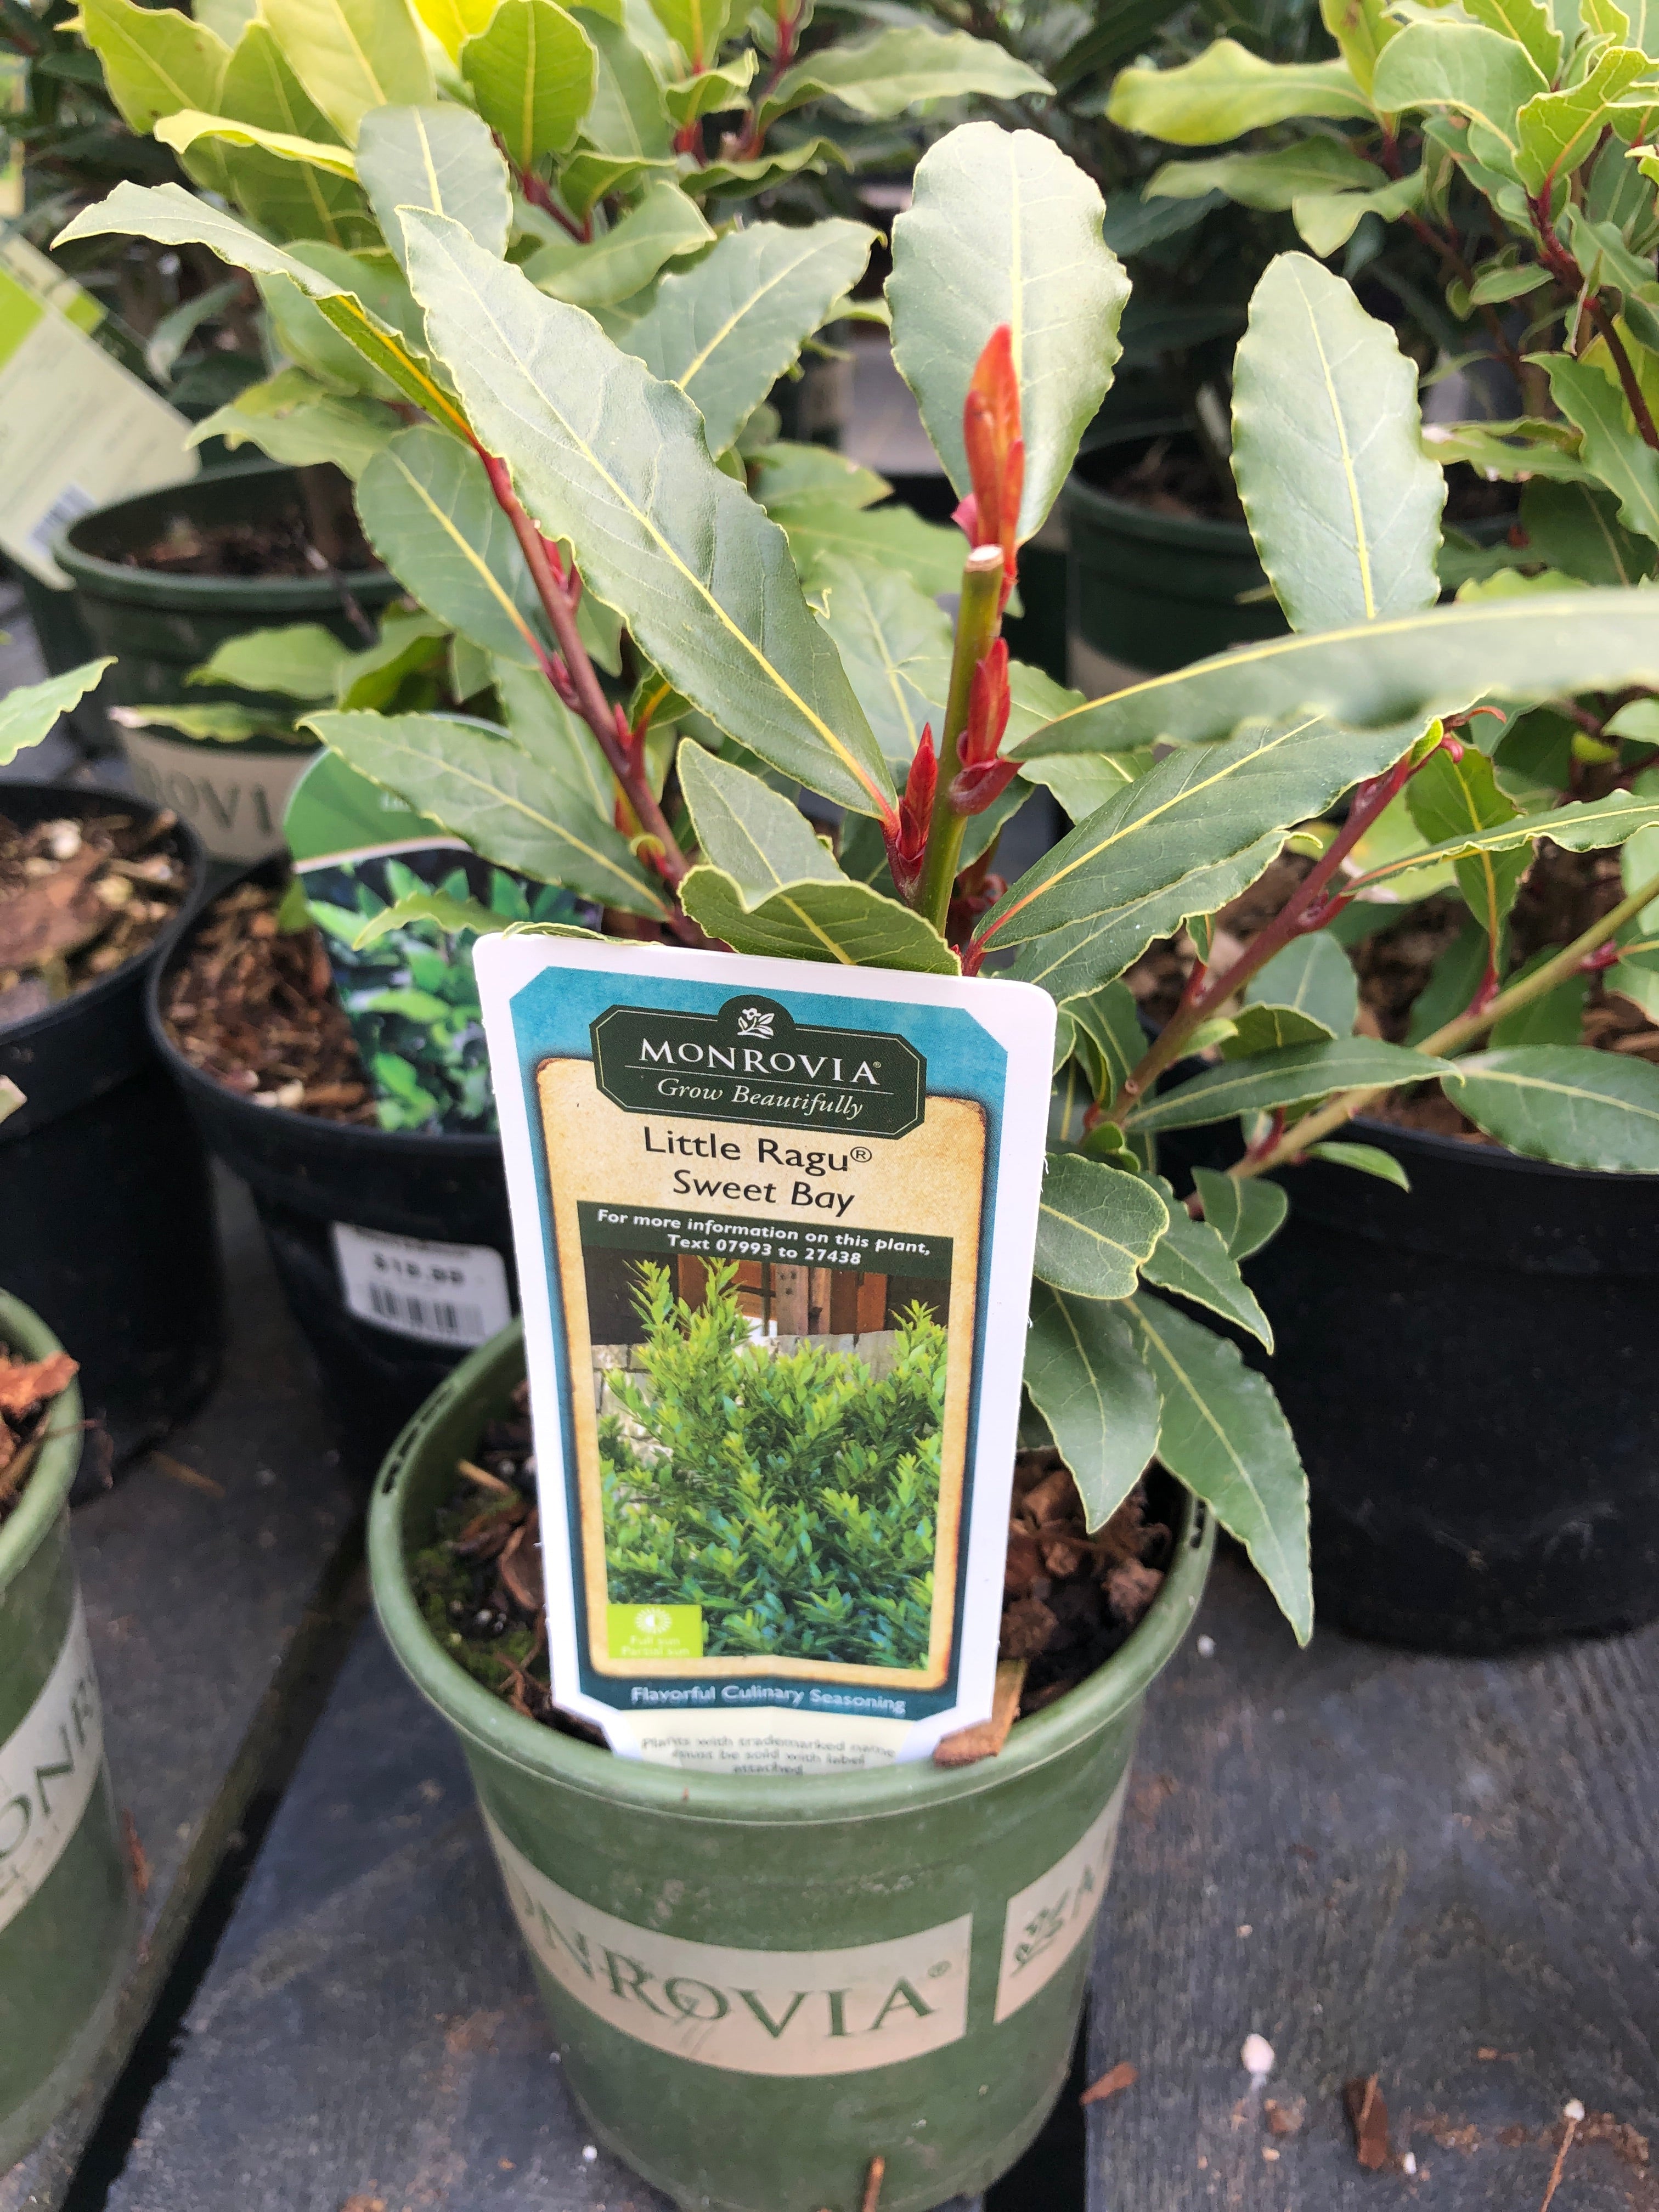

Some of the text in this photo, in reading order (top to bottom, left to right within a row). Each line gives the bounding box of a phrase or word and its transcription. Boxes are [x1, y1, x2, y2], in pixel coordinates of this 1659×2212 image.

[657, 1077, 864, 1120] Grow Beautifully
[644, 1126, 872, 1177] Little Ragu®
[673, 1169, 855, 1217] Sweet Bay
[597, 1209, 931, 1256] For more information on this plant,
[667, 1233, 862, 1266] Text 07993 to 27438
[631, 1685, 906, 1716] Flavorful Culinary Seasoning
[697, 1736, 733, 1746] with
[738, 1734, 845, 1752] trademarked
[746, 1748, 780, 1759] sold
[787, 1752, 821, 1763] with
[826, 1753, 865, 1765] label
